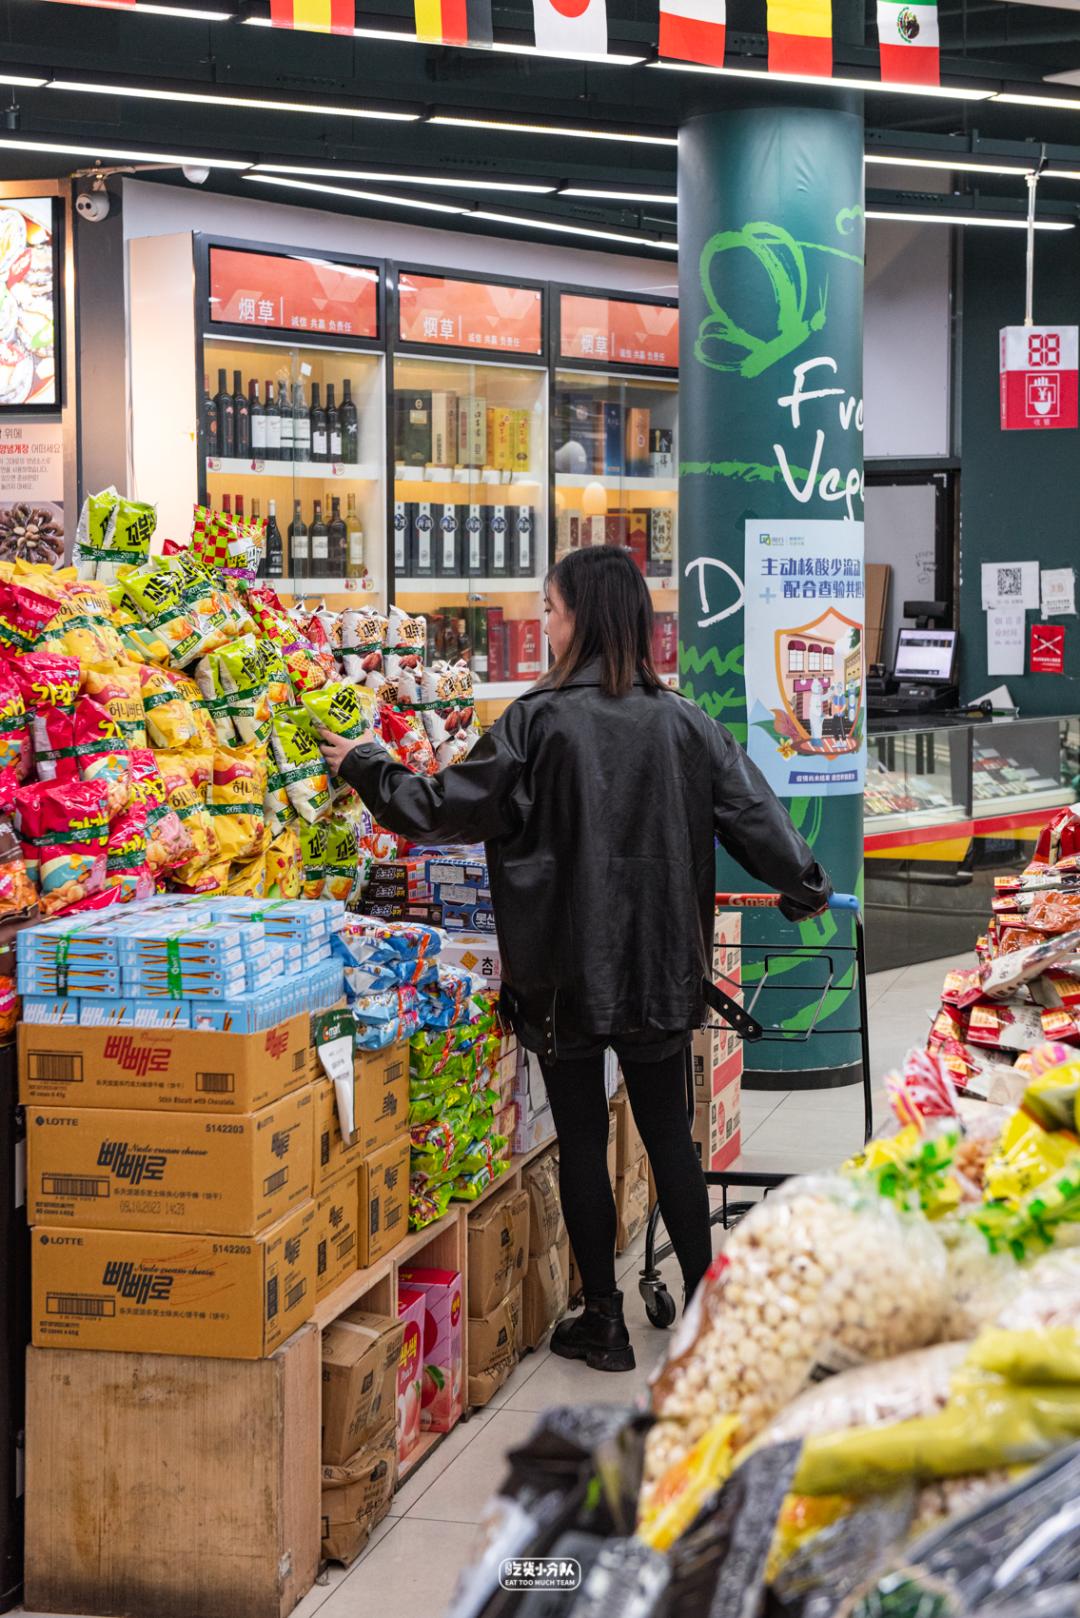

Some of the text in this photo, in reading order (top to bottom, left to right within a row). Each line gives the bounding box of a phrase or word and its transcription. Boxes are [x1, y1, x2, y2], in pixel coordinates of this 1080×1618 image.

[238, 297, 275, 322] 烟草
[423, 317, 455, 340] 烟草
[580, 335, 609, 355] 烟草
[1027, 333, 1061, 367] 88
[772, 429, 864, 522] Veg
[103, 1036, 172, 1077] 빼빼로
[46, 1117, 79, 1127] LOTTE
[205, 1124, 245, 1134] 5142203
[96, 1141, 167, 1185] 빼빼로
[50, 1236, 84, 1246] LOTTE
[212, 1243, 251, 1254] 5142203
[102, 1261, 174, 1305] 빼빼로
